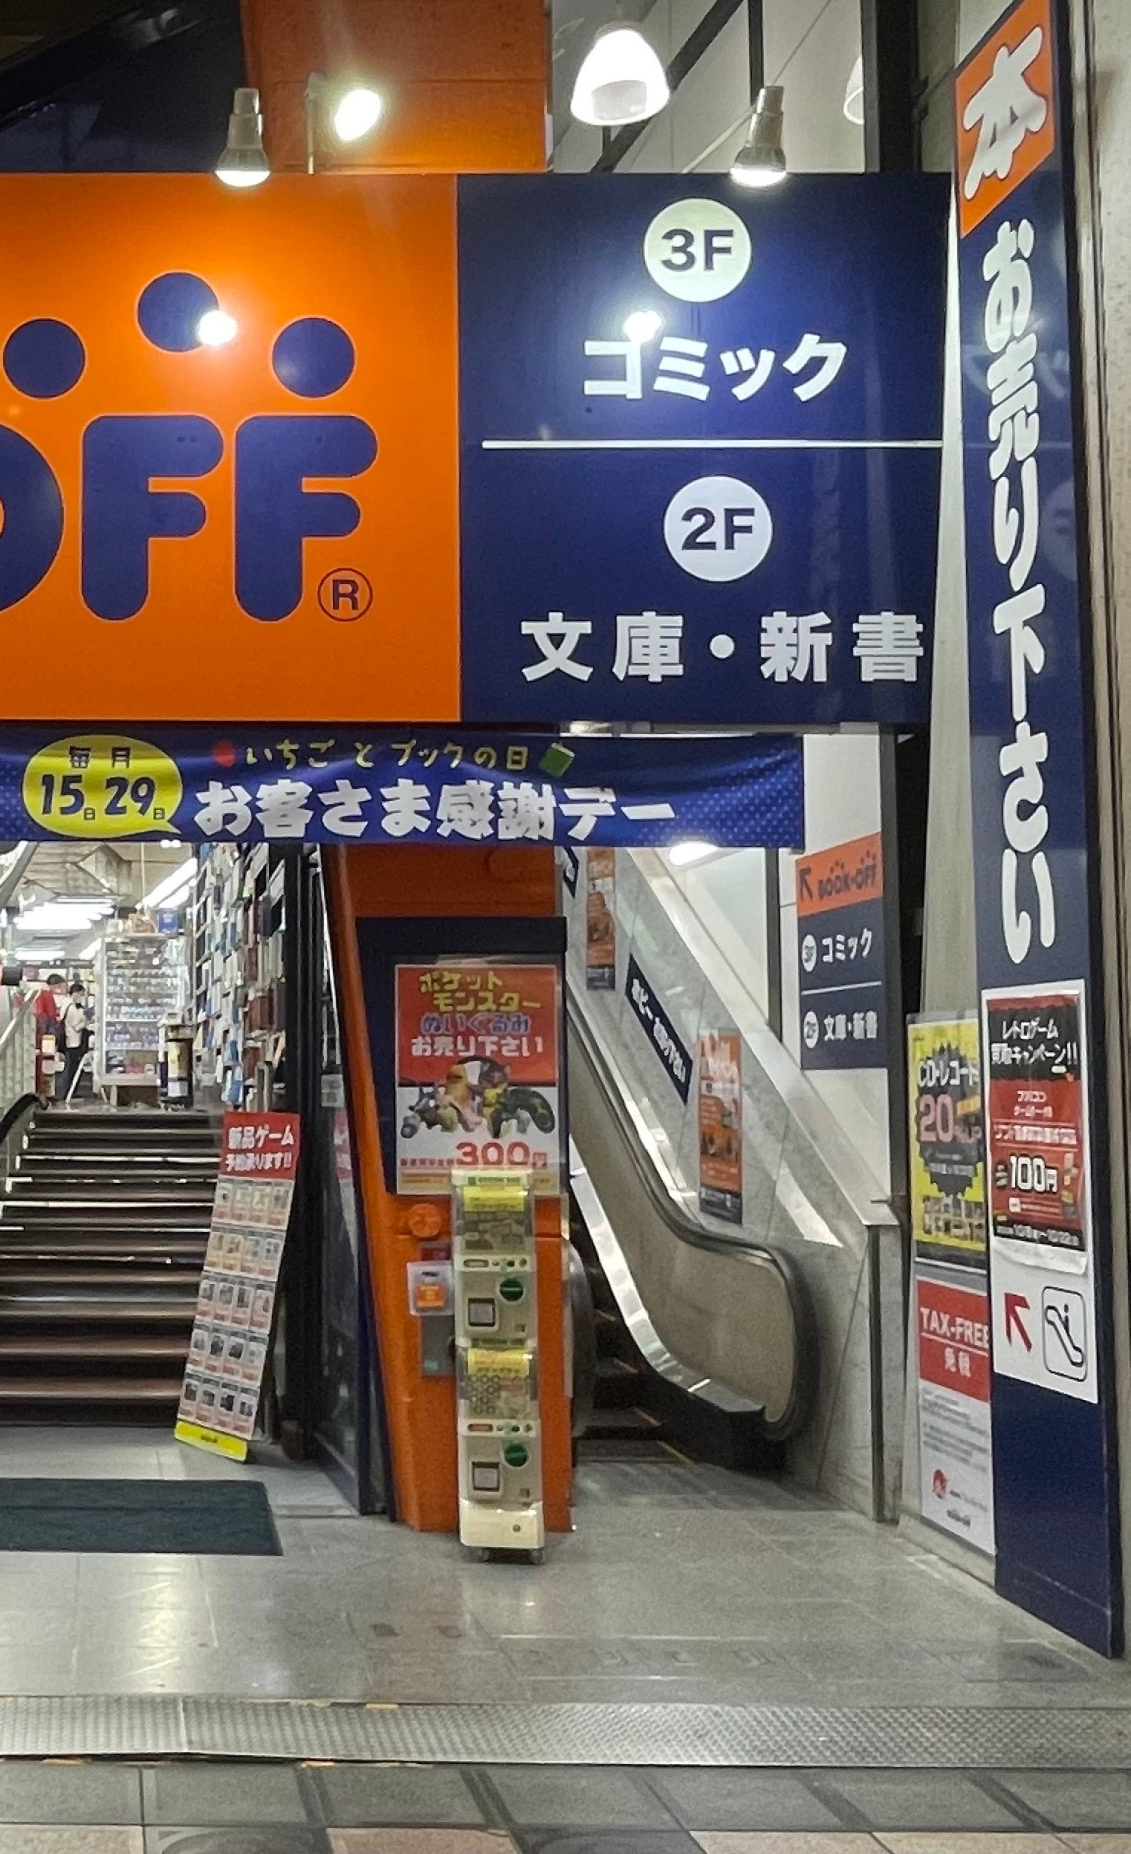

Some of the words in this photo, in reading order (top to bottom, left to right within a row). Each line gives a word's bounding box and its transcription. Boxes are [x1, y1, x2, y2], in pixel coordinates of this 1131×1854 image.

[963, 26, 1047, 200] 本
[660, 228, 734, 271] 3F
[583, 332, 847, 401] コミック
[680, 507, 756, 551] 2F
[982, 218, 1056, 963] お売り下さい
[520, 611, 925, 683] 文庫・新書
[195, 778, 676, 841] お客さま感謝デー
[821, 928, 873, 963] コミック
[419, 971, 503, 993] ポケット
[433, 992, 542, 1013] モンスター
[421, 1013, 532, 1035] ぬいぐるみ
[1002, 1016, 1059, 1040] レトロゲーム
[411, 1035, 544, 1058] お売り下さい
[920, 1307, 989, 1350] TAX-FREE
